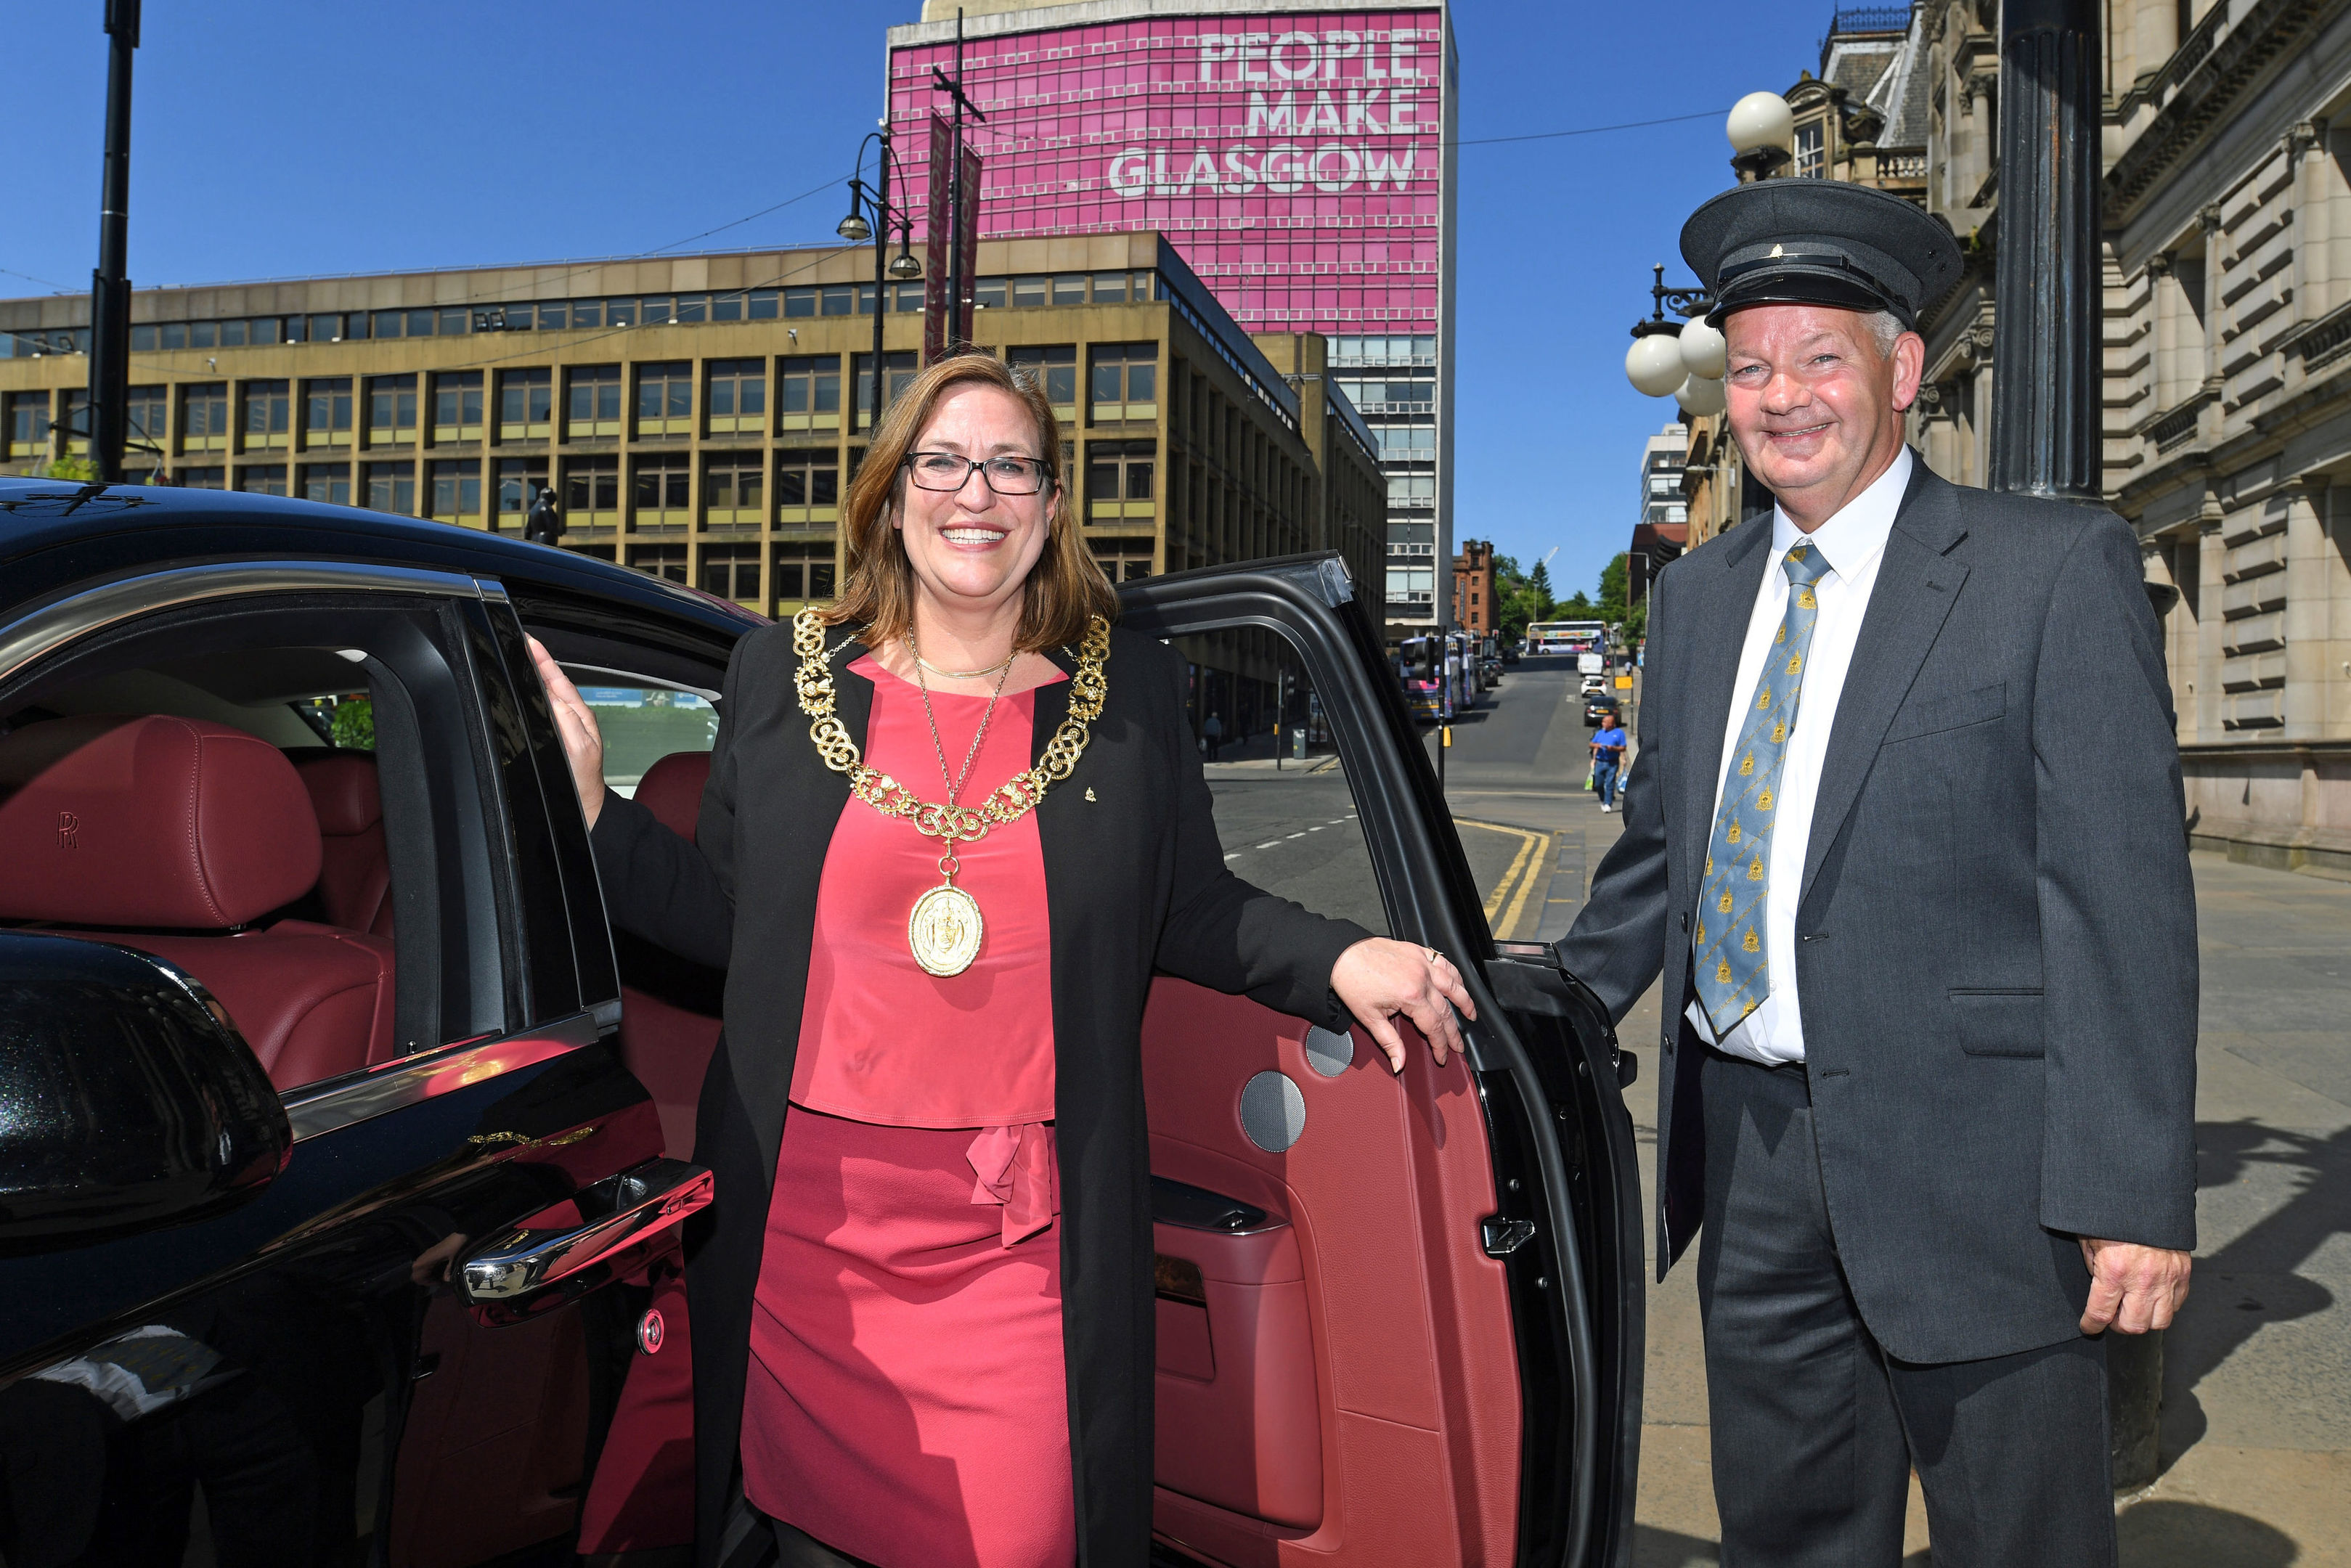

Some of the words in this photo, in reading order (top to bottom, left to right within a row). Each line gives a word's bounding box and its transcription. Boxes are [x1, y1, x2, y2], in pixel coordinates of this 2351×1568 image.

[1202, 29, 1421, 81] PEOPLE
[1248, 86, 1420, 135] MAKE
[929, 129, 946, 249] PEOPLE
[1109, 142, 1419, 197] GLASGOW
